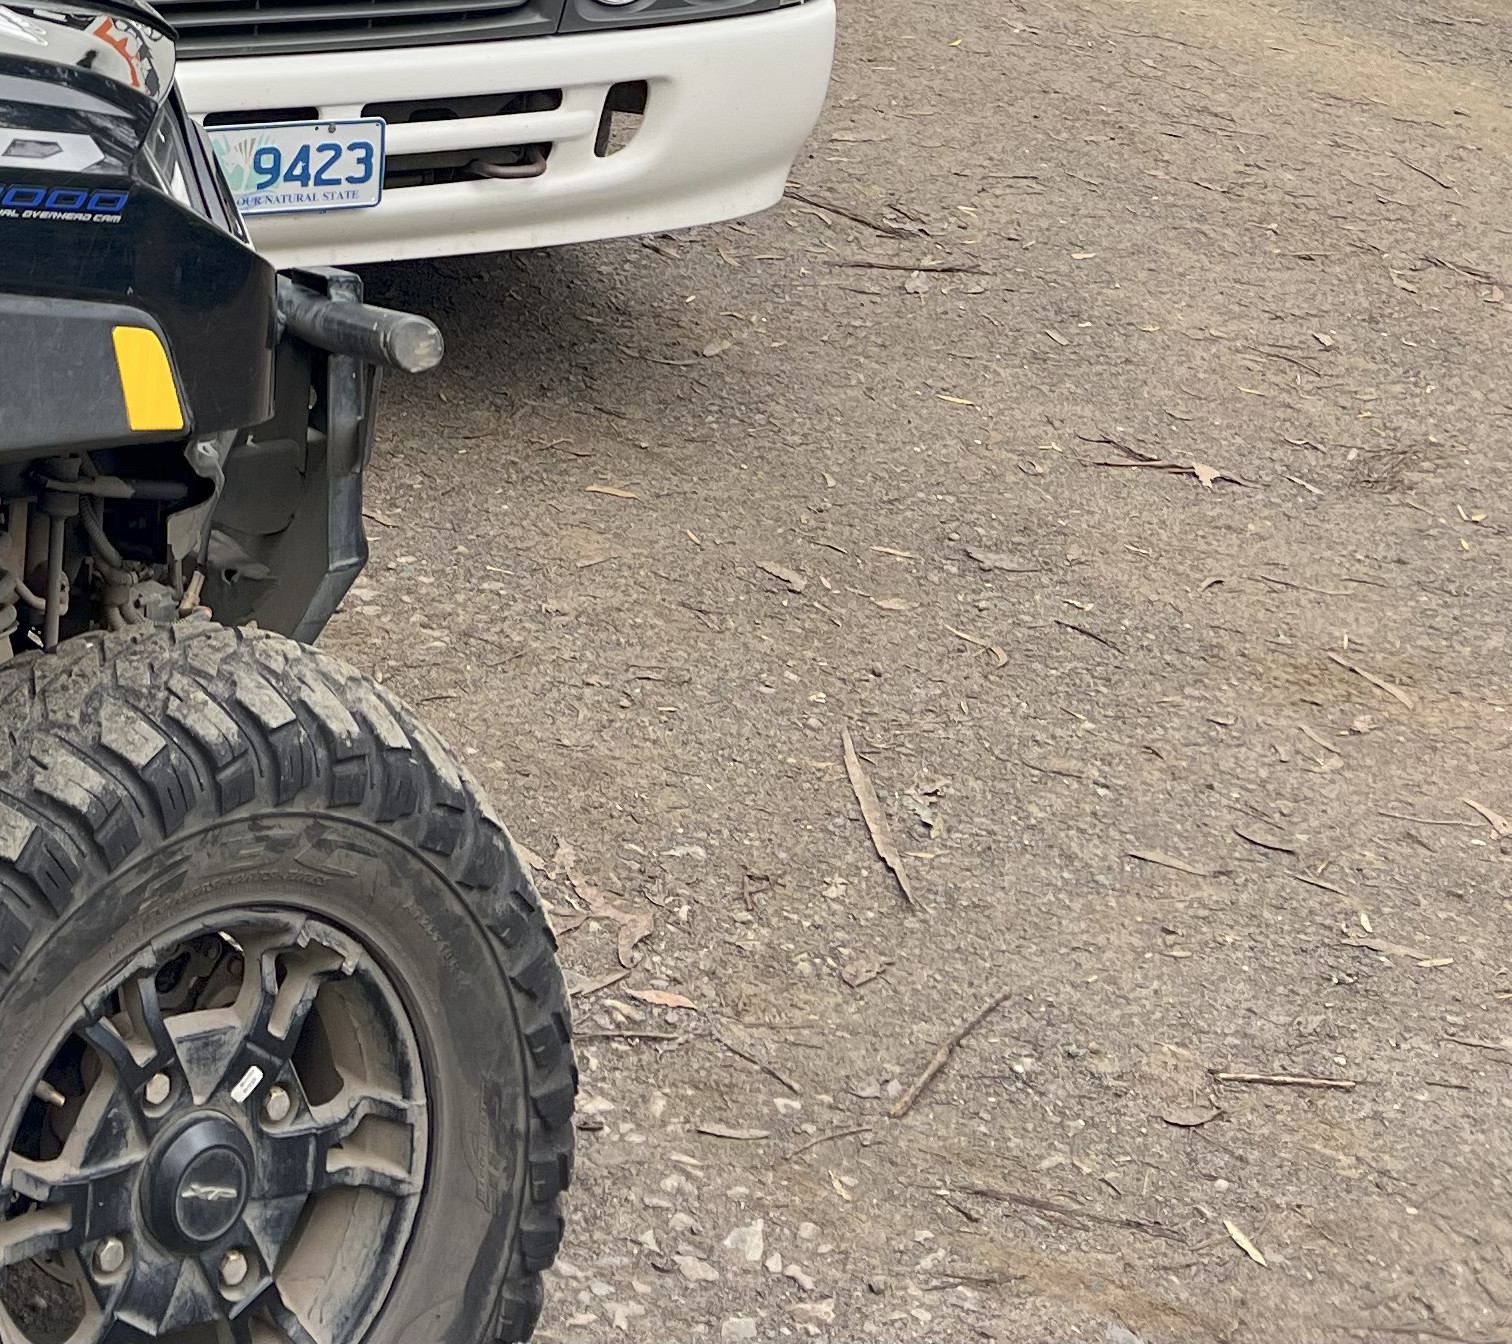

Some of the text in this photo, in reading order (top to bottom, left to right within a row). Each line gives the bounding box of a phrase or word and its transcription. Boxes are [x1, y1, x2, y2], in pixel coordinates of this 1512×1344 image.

[252, 141, 375, 190] 9423
[263, 193, 320, 204] NATURAL
[322, 190, 361, 201] STATE
[21, 210, 91, 222] OVERHEAD
[92, 213, 122, 224] CAM
